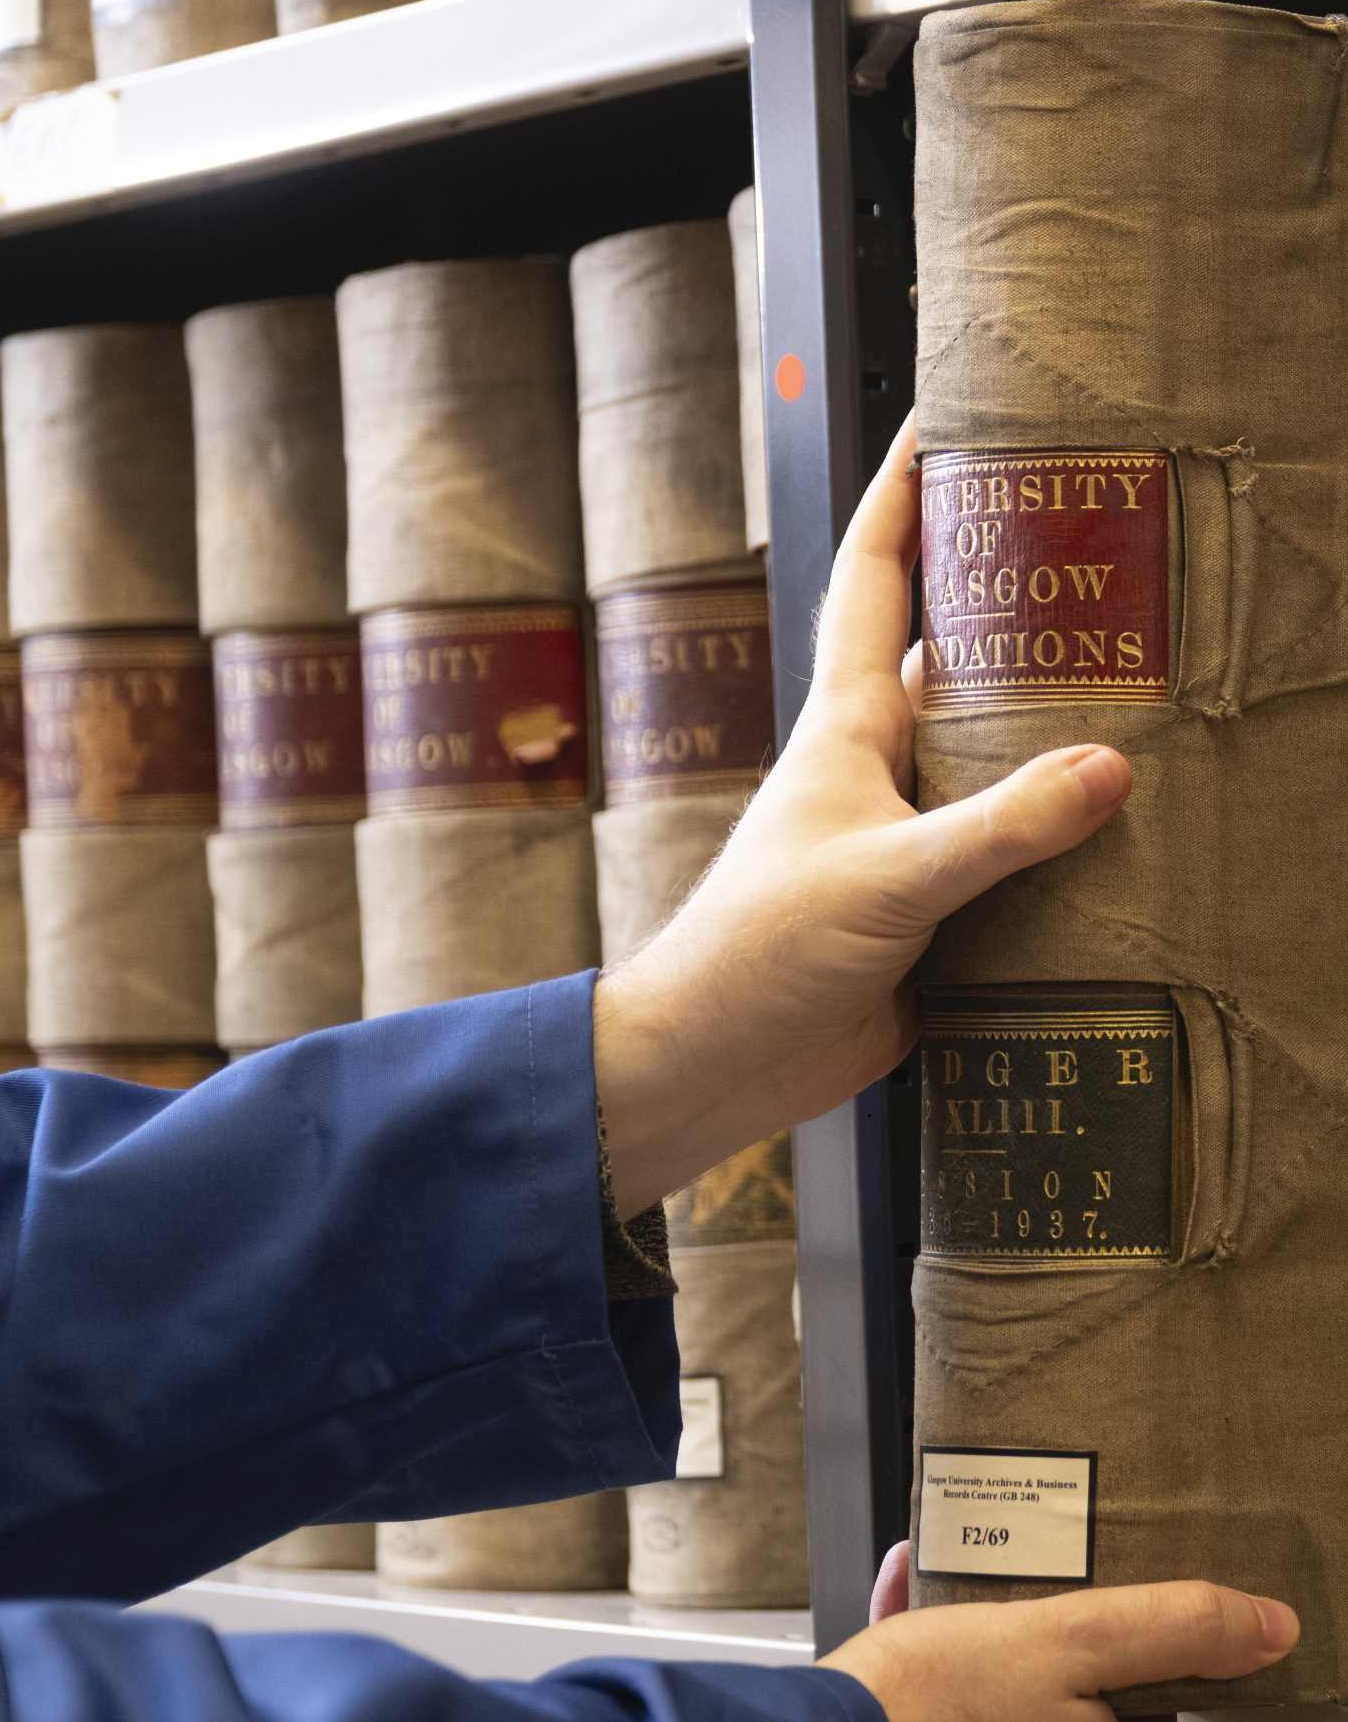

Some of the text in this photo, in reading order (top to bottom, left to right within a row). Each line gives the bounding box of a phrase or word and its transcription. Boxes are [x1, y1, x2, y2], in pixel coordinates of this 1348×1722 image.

[956, 520, 1002, 558] OF
[944, 1099, 1087, 1136] XLIII.
[986, 1478, 1022, 1488] Archives
[1024, 1478, 1033, 1488] &
[1037, 1479, 1078, 1489] Business
[971, 1490, 998, 1500] Centre
[1000, 1491, 1018, 1503] (GB
[961, 1526, 1010, 1546] F2/69
